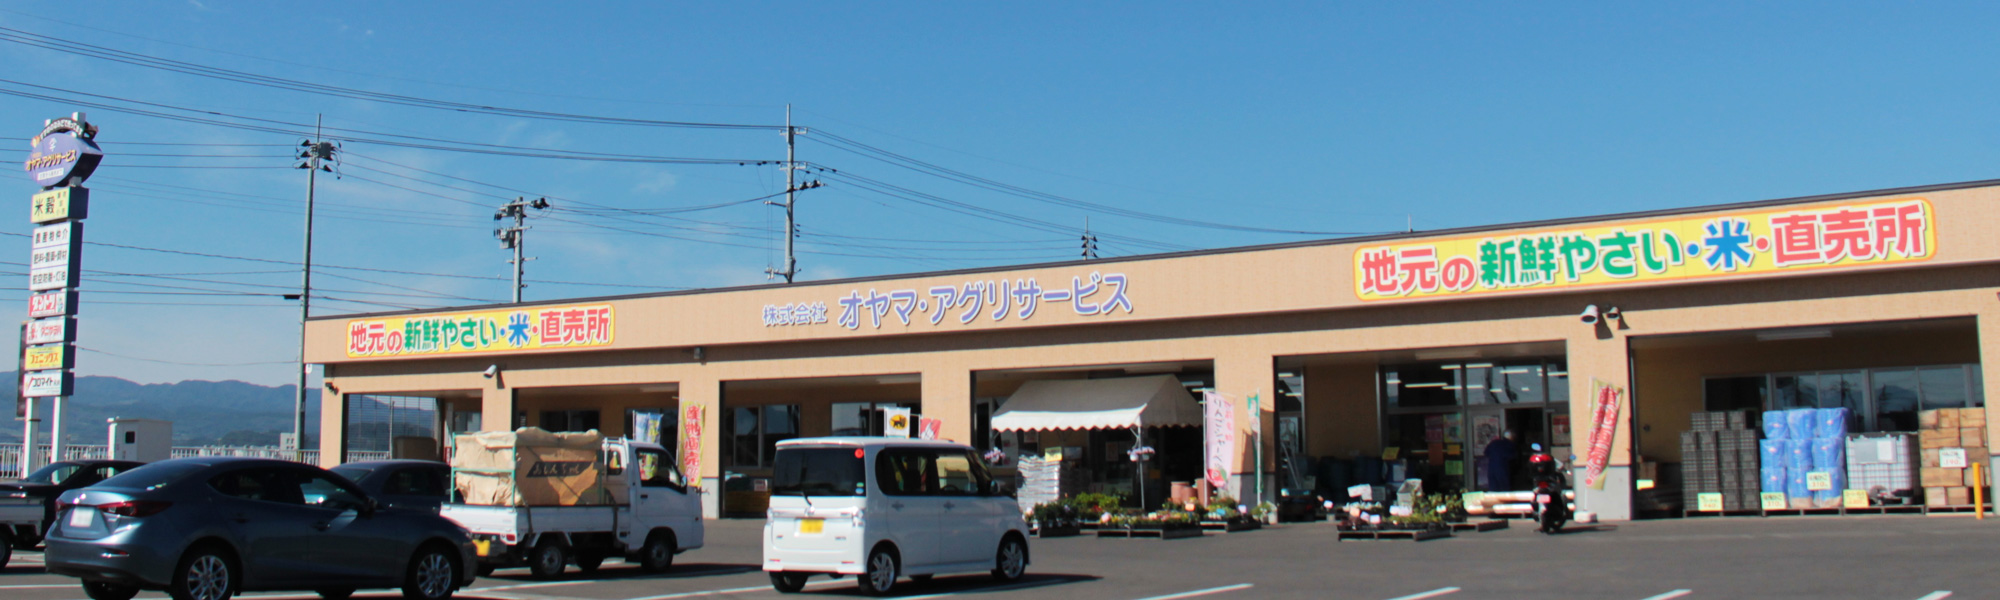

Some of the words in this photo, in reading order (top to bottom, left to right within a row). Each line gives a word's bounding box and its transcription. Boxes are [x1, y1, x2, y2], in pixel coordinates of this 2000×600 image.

[1360, 203, 1924, 293] 地元の新鮮やさい・米・直売所
[762, 302, 827, 327] 株式会社
[838, 273, 1133, 330] オヤマ・アグリサービス
[350, 308, 611, 353] 地元の新鮮やさい・米・直売所
